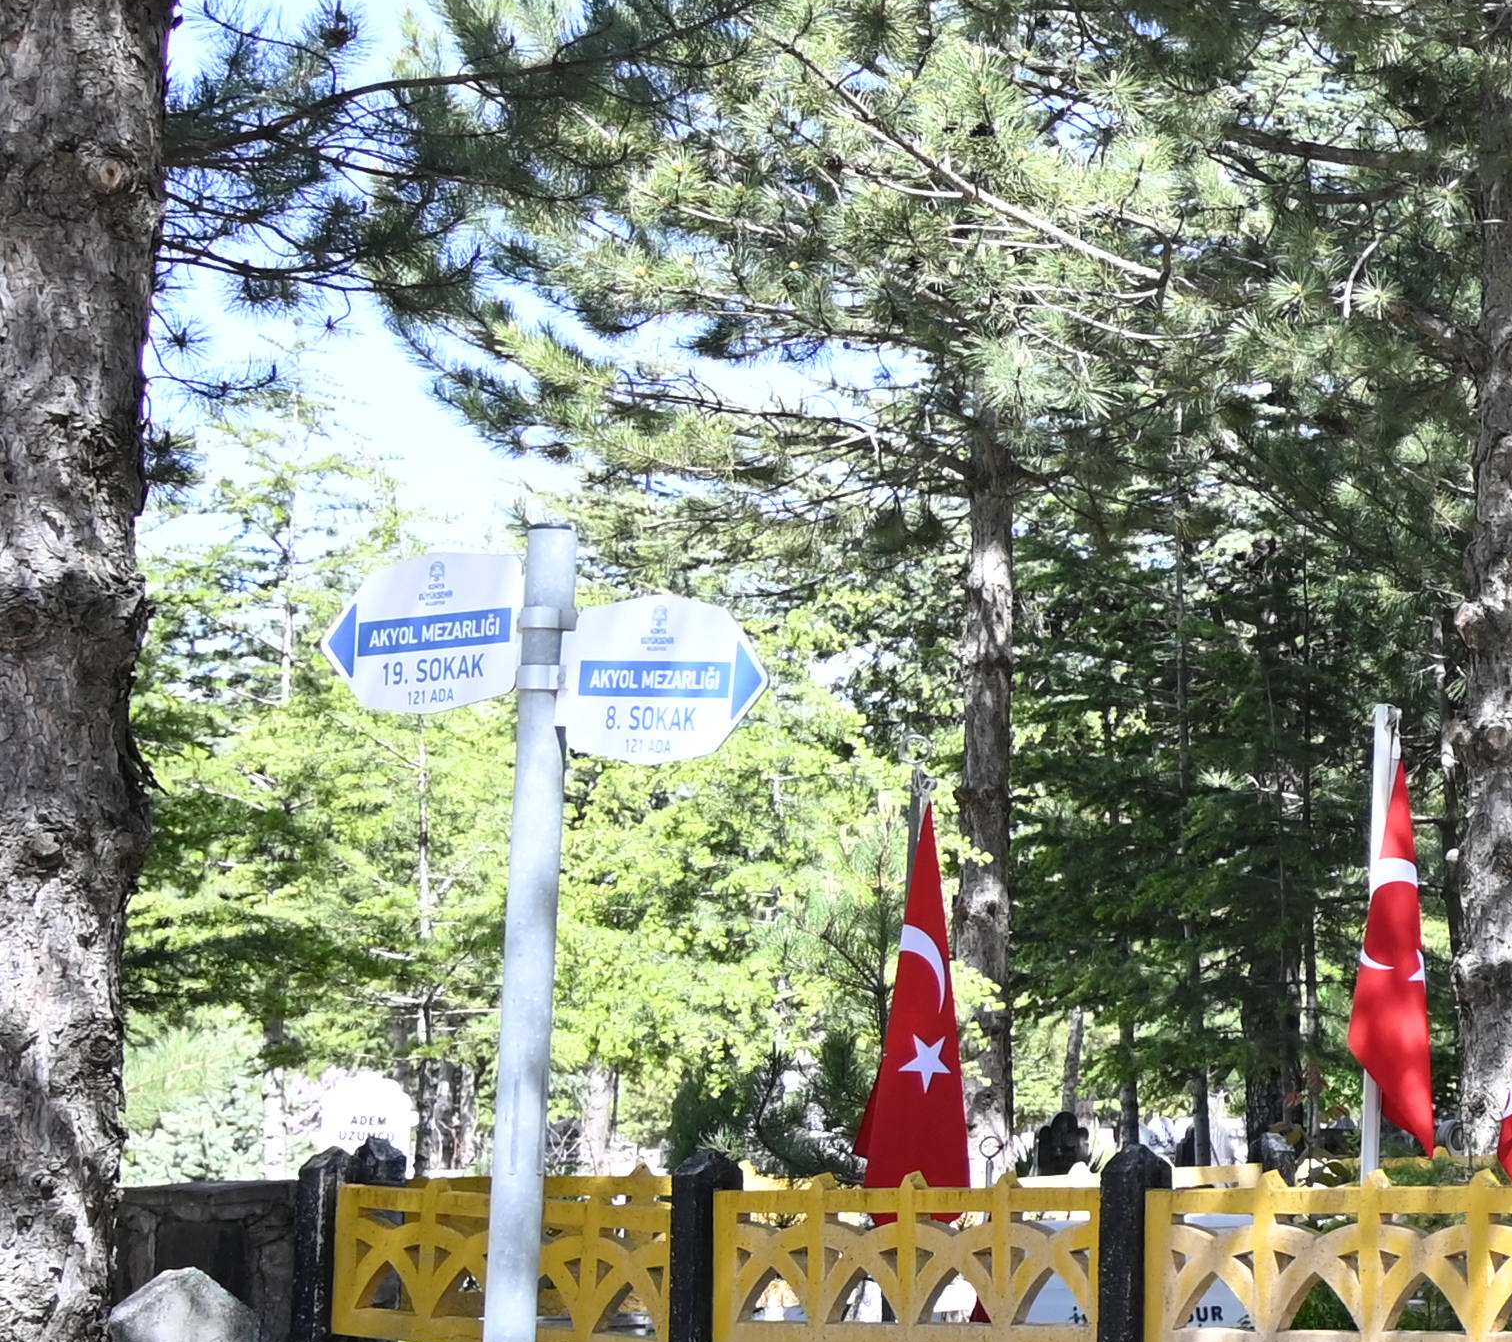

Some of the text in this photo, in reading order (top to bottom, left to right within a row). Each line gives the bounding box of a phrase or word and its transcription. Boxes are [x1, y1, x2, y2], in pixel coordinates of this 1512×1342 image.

[369, 613, 501, 648] AKYOL MEZARLIĞI
[383, 653, 485, 686] 19. SOKAK
[589, 666, 721, 690] AKYOL MEZARLIĞI
[408, 688, 455, 705] 121 ADA
[605, 705, 697, 732] 8. SOKAK
[625, 739, 672, 754] 121 ADA
[350, 1115, 387, 1126] ADEM
